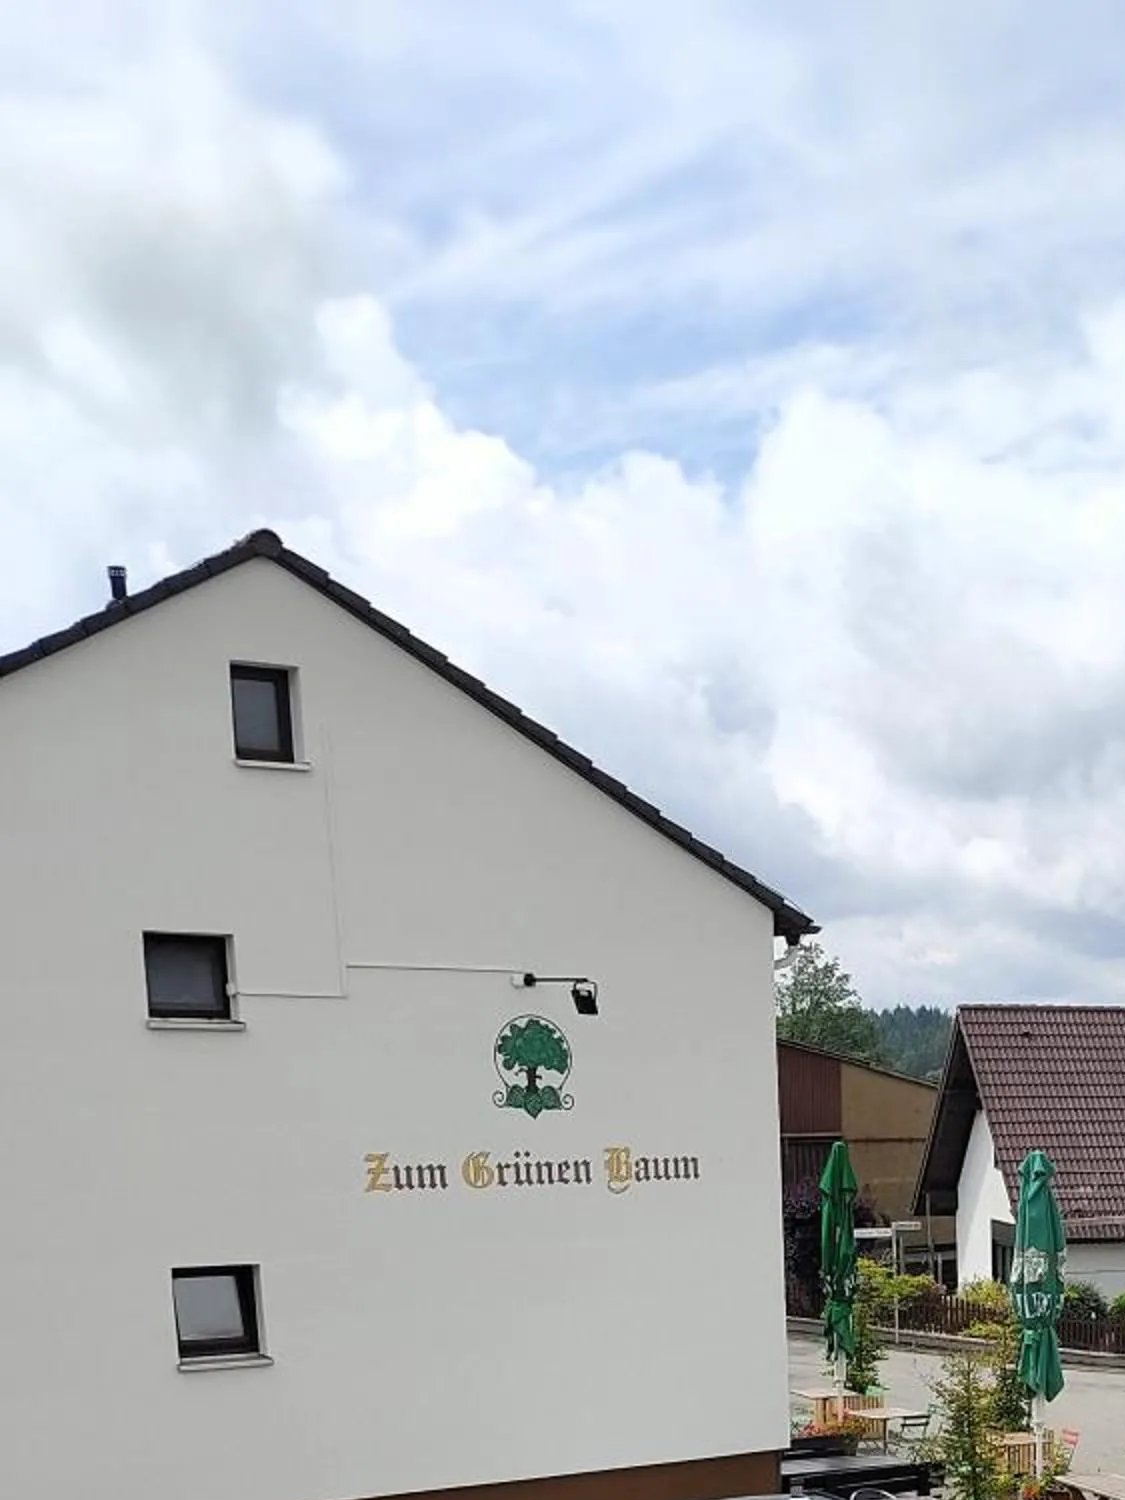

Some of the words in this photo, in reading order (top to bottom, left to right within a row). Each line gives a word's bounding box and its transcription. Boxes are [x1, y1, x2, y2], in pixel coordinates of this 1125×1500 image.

[364, 1151, 448, 1193] Zum
[461, 1151, 592, 1188] Grünen
[604, 1146, 700, 1194] Baum
